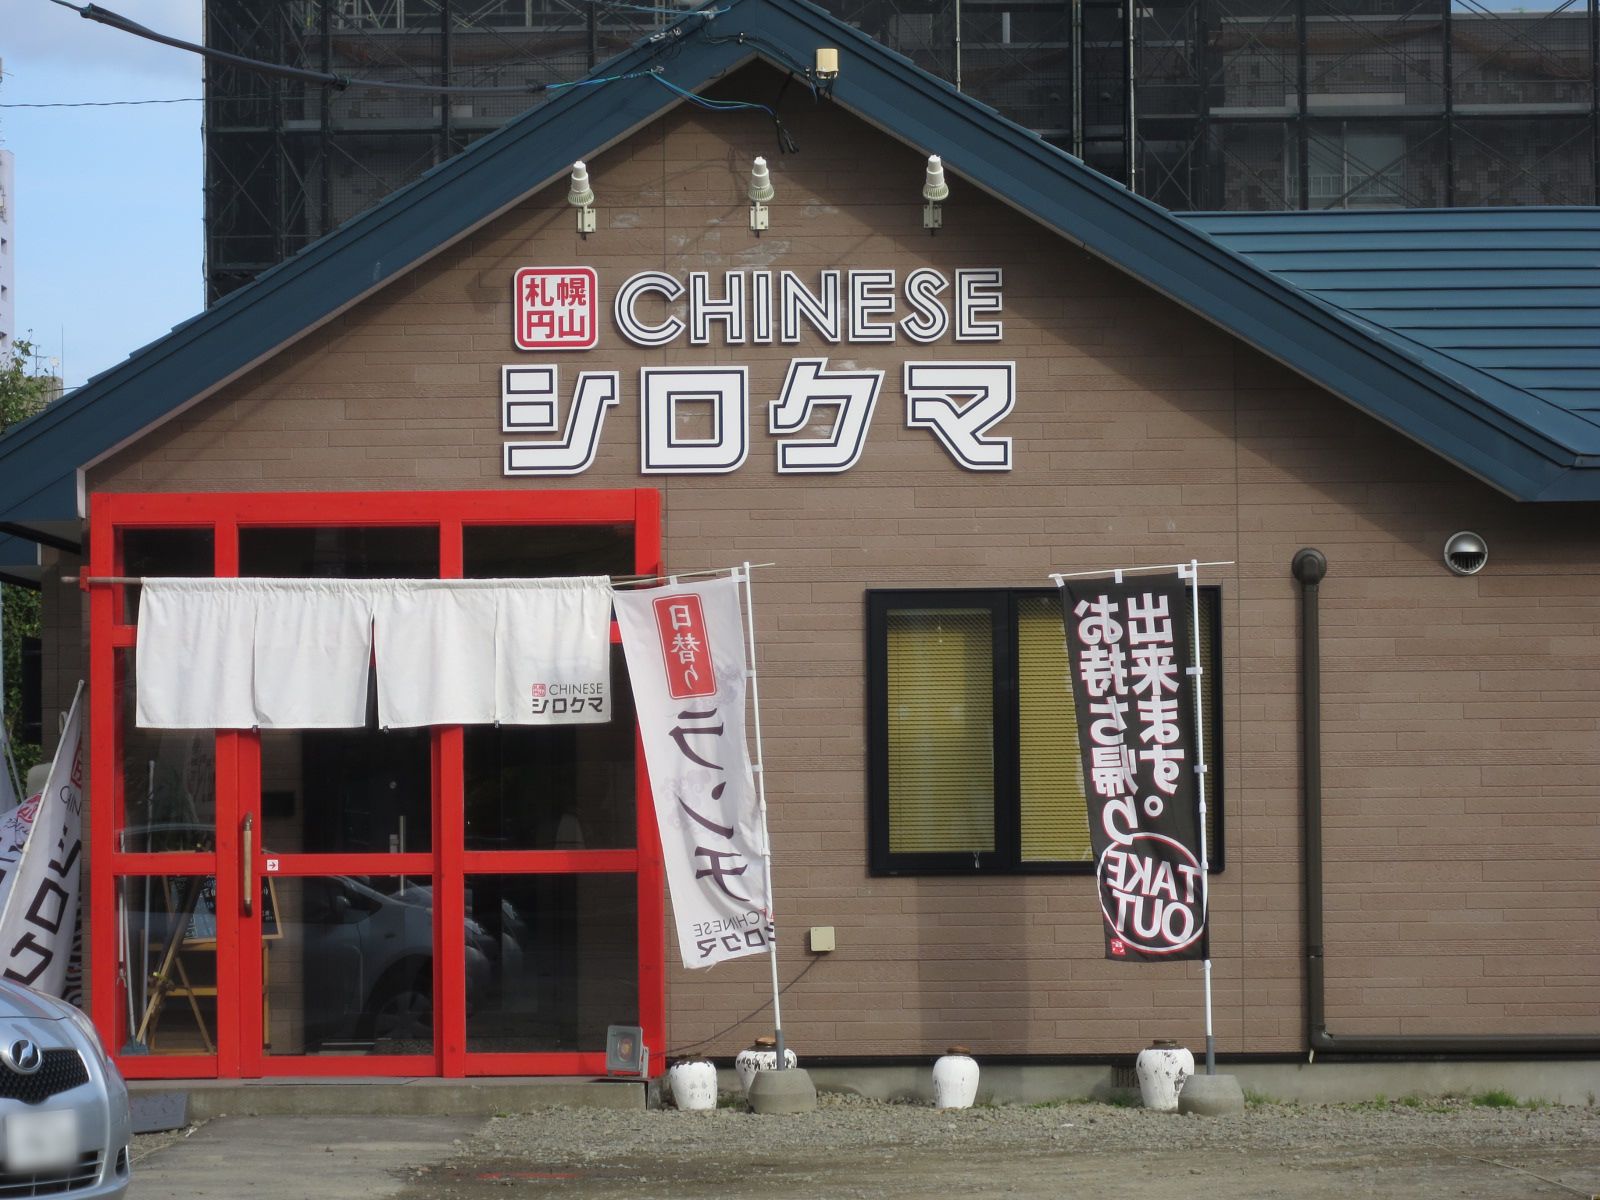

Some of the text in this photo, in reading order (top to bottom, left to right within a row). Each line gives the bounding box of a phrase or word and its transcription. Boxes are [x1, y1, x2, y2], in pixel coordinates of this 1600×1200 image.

[525, 276, 587, 307] 札幌
[614, 267, 1003, 346] CHINESE
[526, 308, 586, 339] 円山
[502, 357, 1016, 476] シロクマ
[548, 682, 603, 696] CHINESE
[532, 697, 603, 714] シロクマ
